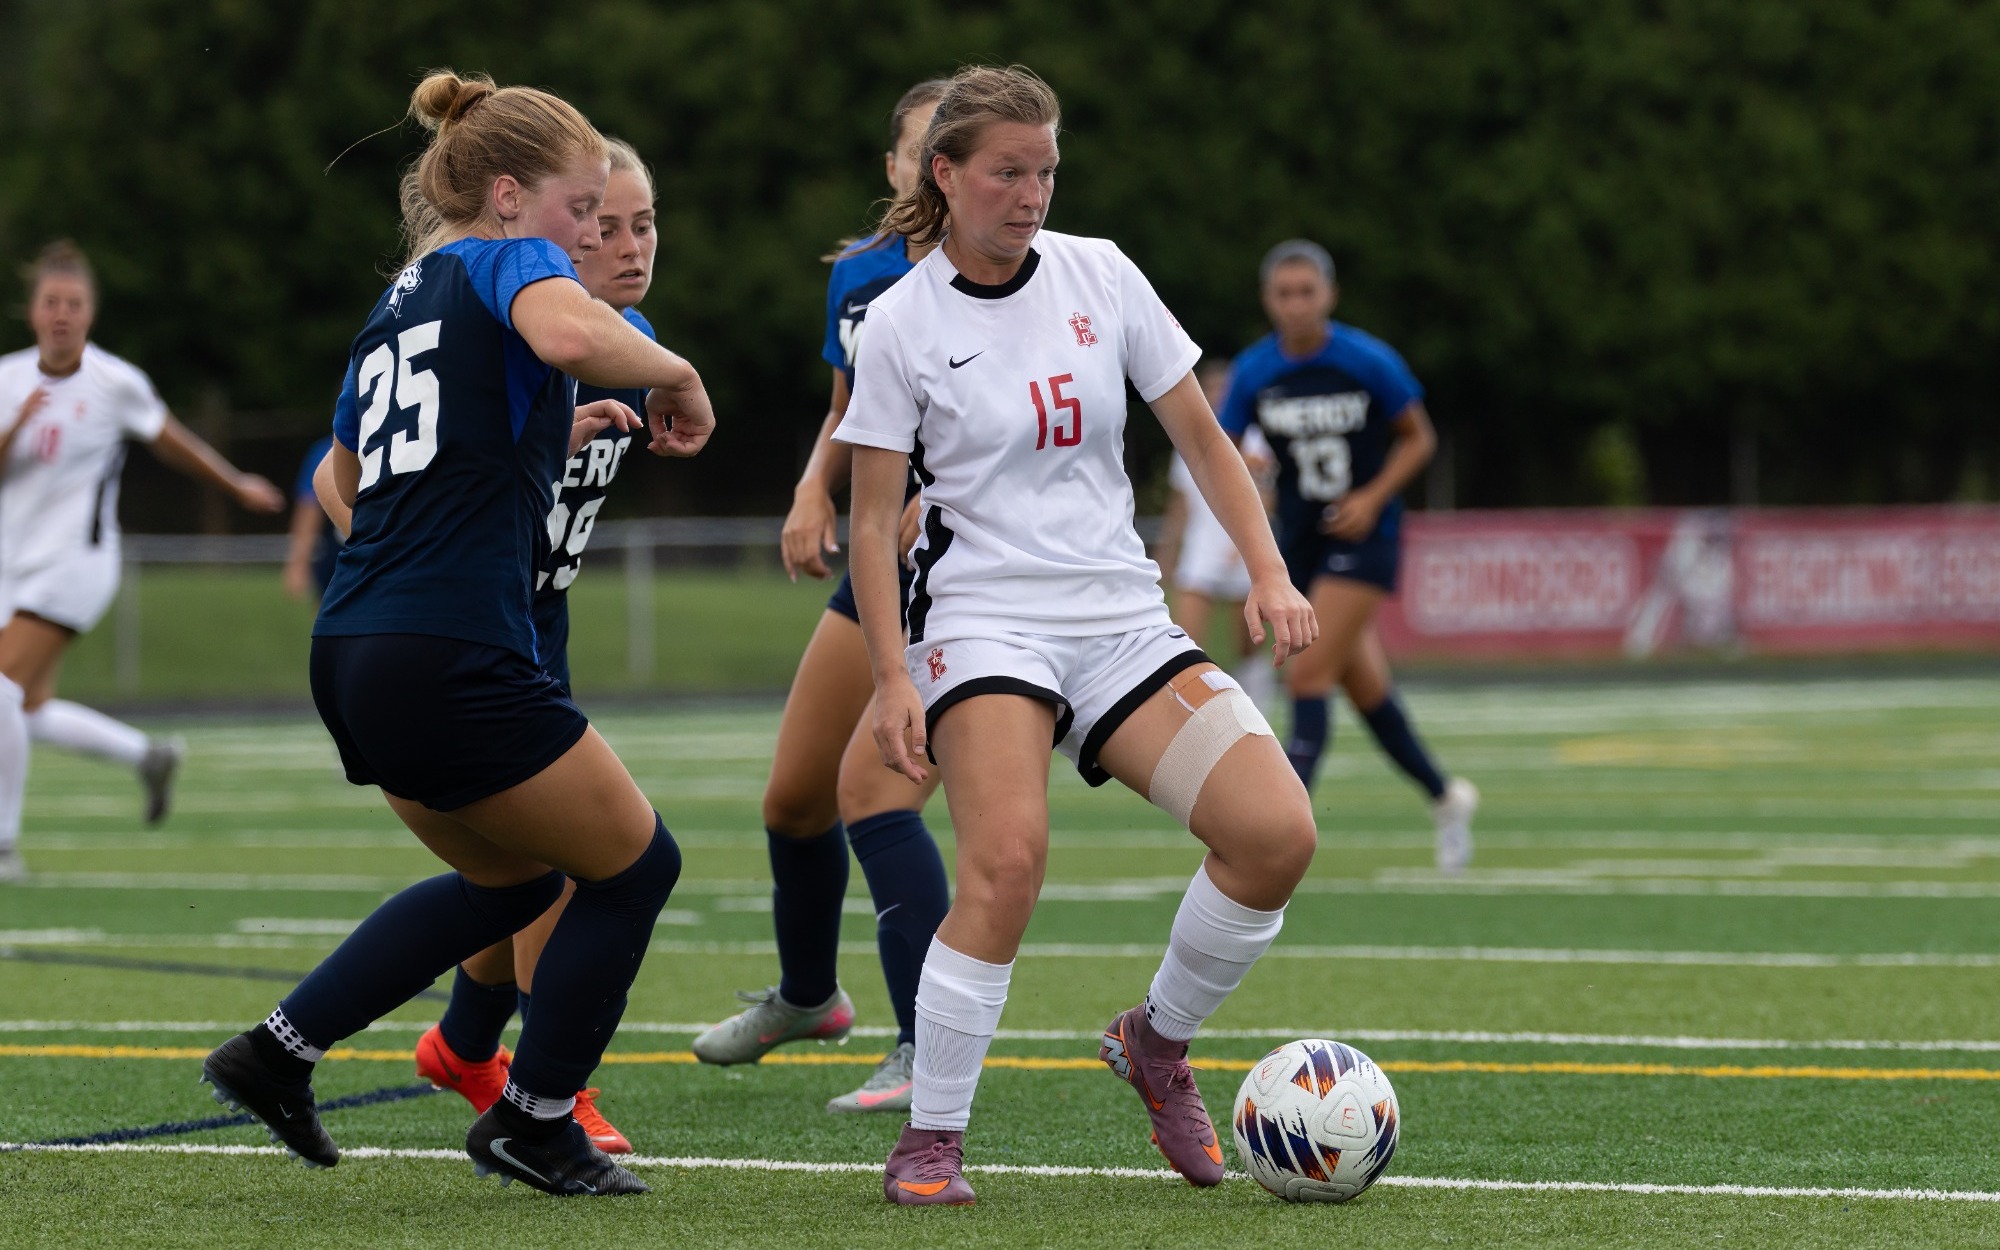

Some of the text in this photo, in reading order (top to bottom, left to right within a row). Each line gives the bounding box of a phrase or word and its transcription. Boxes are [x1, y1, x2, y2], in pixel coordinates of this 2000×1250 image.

[357, 319, 442, 493] 25
[1029, 373, 1082, 451] 15
[1289, 437, 1352, 502] 13
